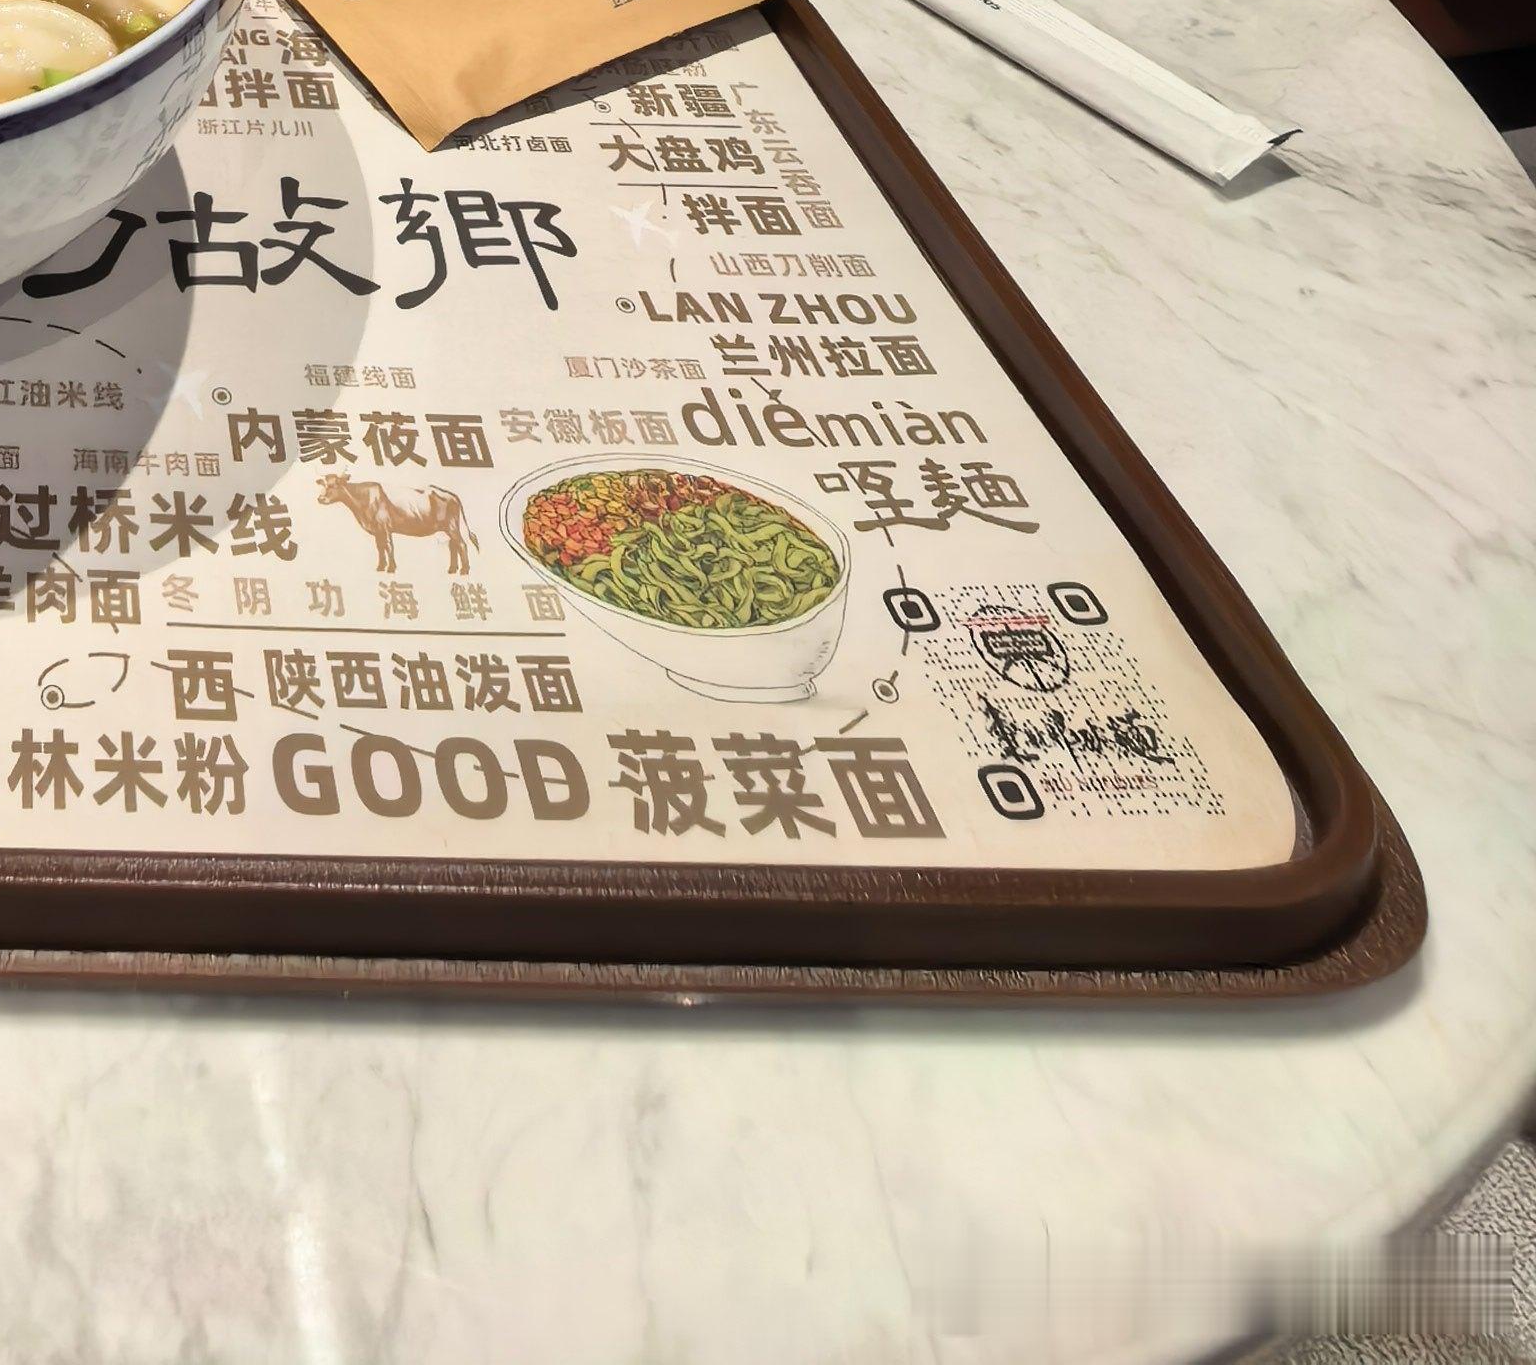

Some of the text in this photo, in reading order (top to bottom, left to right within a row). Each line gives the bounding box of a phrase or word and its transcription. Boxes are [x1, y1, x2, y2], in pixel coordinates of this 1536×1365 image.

[626, 83, 736, 119] 新疆
[197, 118, 314, 138] 浙江片儿川
[453, 133, 573, 154] 河北打卤面
[599, 135, 766, 176] 大盘鸡
[729, 81, 845, 231] 广东云吞面
[682, 193, 802, 237] 拌面
[710, 251, 879, 278] 山西刀削面
[638, 290, 918, 325] LAN ZHOU
[303, 362, 418, 391] 福建线面
[563, 356, 707, 381] 厦门沙茶面
[709, 333, 939, 379] 兰州拉面
[226, 406, 495, 469] 内蒙莜面
[498, 406, 680, 448] 安徽板面
[72, 448, 222, 478] 海南牛肉面
[161, 573, 566, 622] 冬阴功海鲜面
[262, 648, 584, 714] 陕西油泼面
[271, 732, 592, 821] GOOD
[606, 729, 946, 839] 菠菜面
